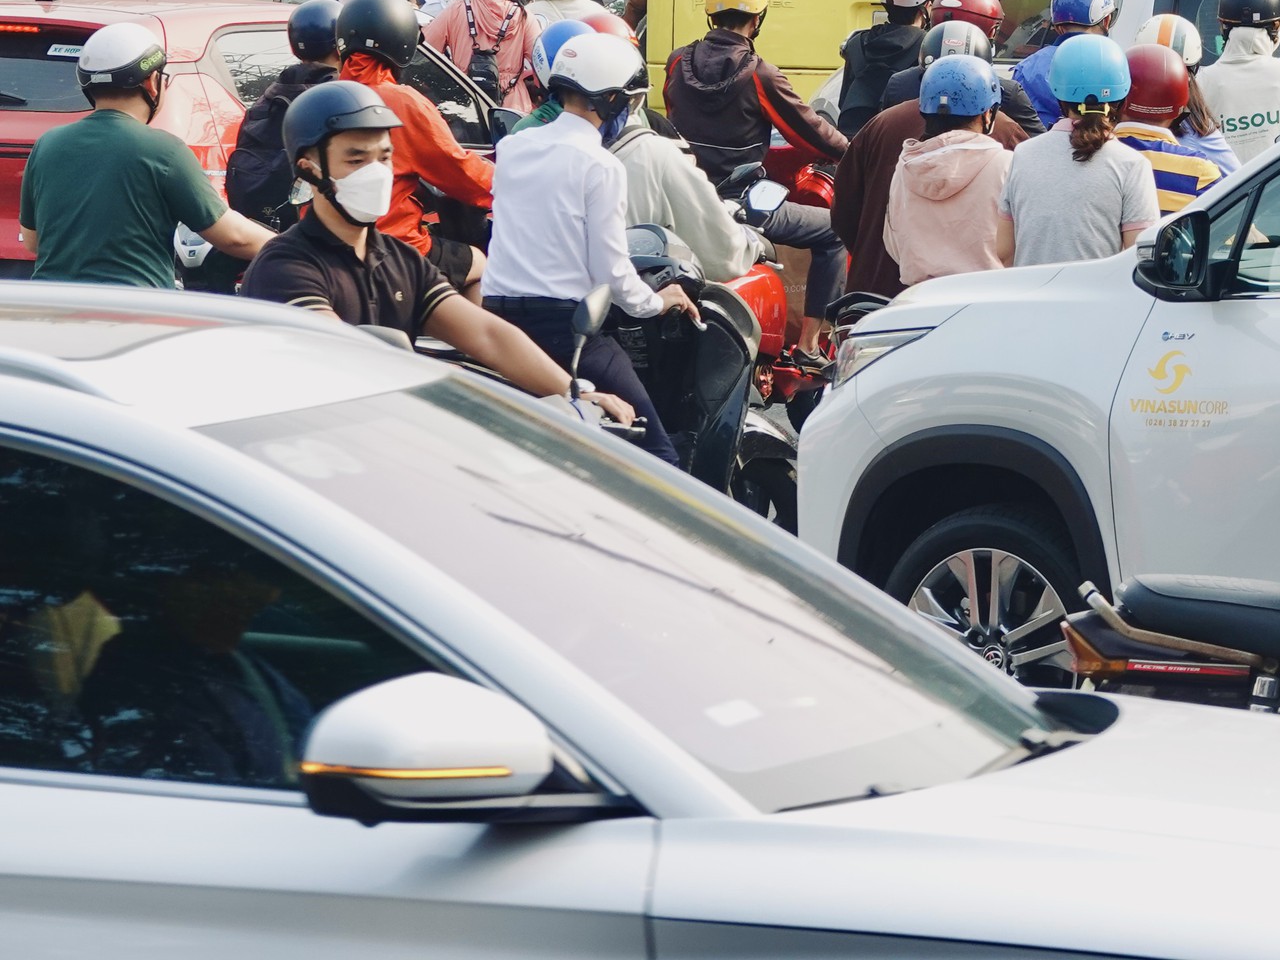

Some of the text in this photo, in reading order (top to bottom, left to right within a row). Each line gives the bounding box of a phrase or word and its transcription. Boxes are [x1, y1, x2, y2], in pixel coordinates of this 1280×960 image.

[1145, 419, 1165, 427] (028)
[1202, 420, 1211, 428] 27
[1133, 663, 1167, 671] ELECTRIC
